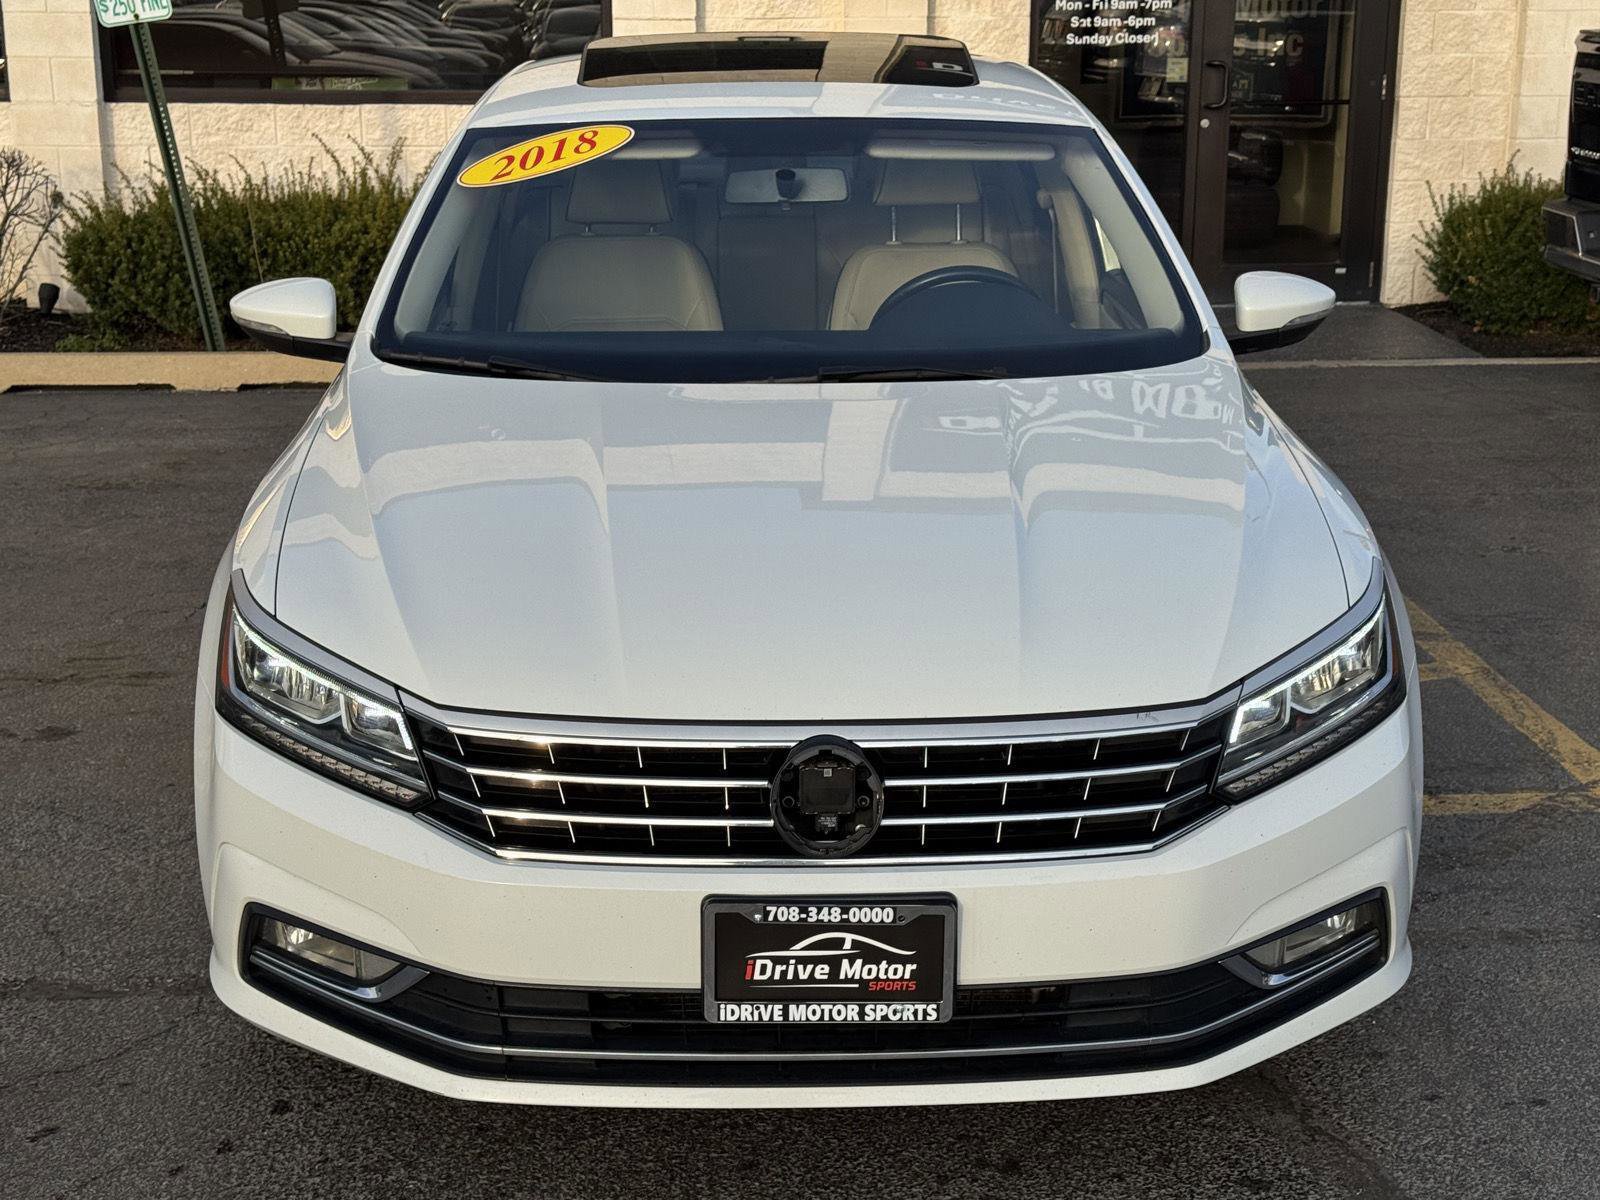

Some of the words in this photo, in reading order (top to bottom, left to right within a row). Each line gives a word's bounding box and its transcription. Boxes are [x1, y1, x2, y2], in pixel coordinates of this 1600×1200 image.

[1055, 0, 1083, 11] Mon
[1111, 0, 1138, 10] 9am
[1070, 16, 1092, 28] Sat
[1093, 16, 1121, 27] 9am
[1066, 33, 1113, 46] Sunday
[1115, 32, 1159, 44] Closed
[489, 130, 599, 182] 2018
[766, 906, 894, 923] 708-348-0000
[744, 958, 830, 981] iDrive
[839, 958, 917, 980] Motor
[868, 981, 917, 991] SPORTS
[788, 1004, 859, 1021] MOTOR
[864, 1004, 938, 1022] SPORTS
